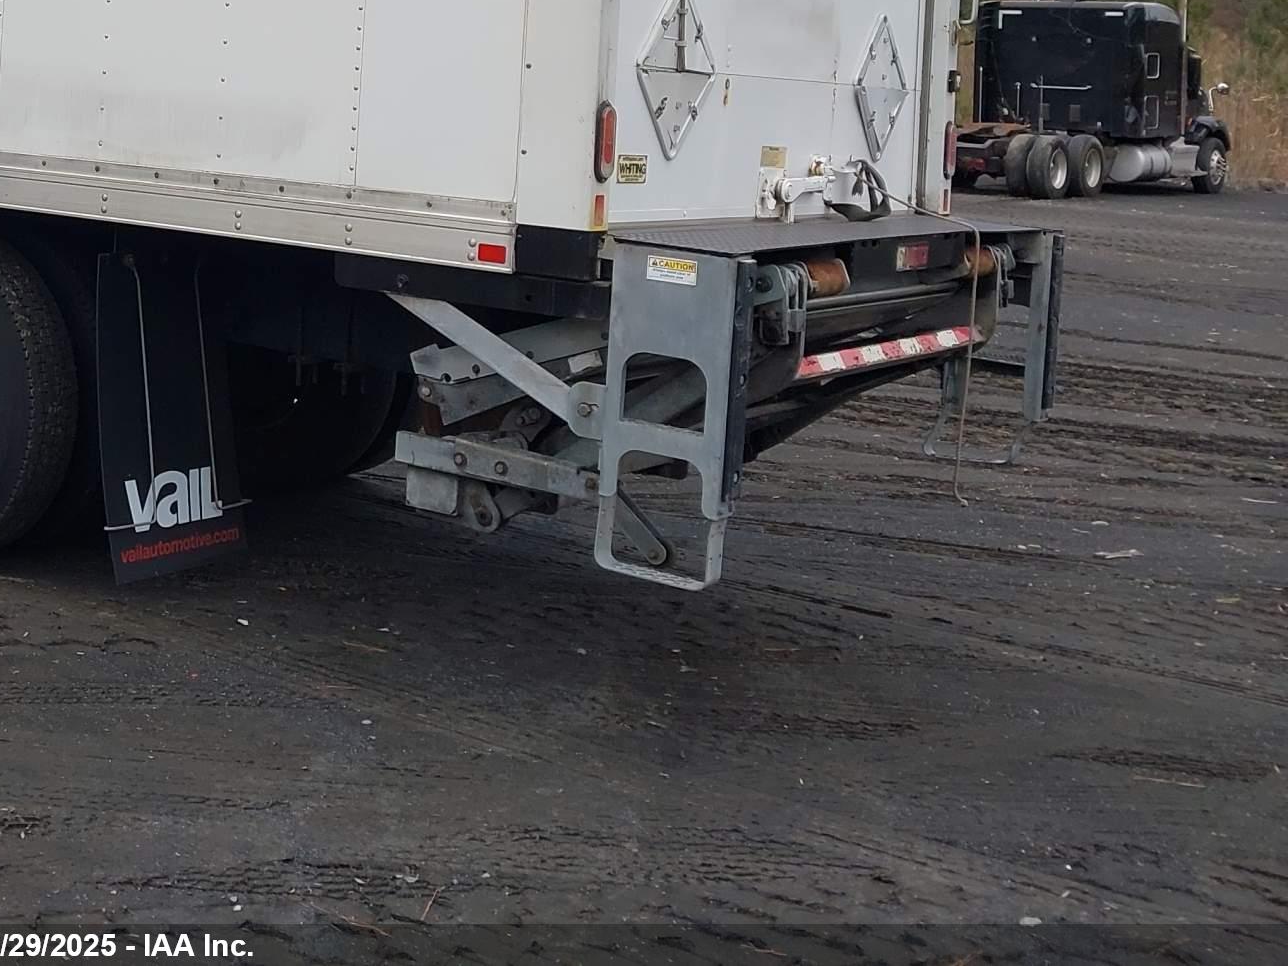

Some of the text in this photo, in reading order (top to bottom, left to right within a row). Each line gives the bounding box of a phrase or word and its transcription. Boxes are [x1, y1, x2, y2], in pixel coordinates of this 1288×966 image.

[619, 163, 647, 175] WHITING
[659, 260, 695, 272] CAUTION
[120, 527, 240, 564] vailautomotive.com
